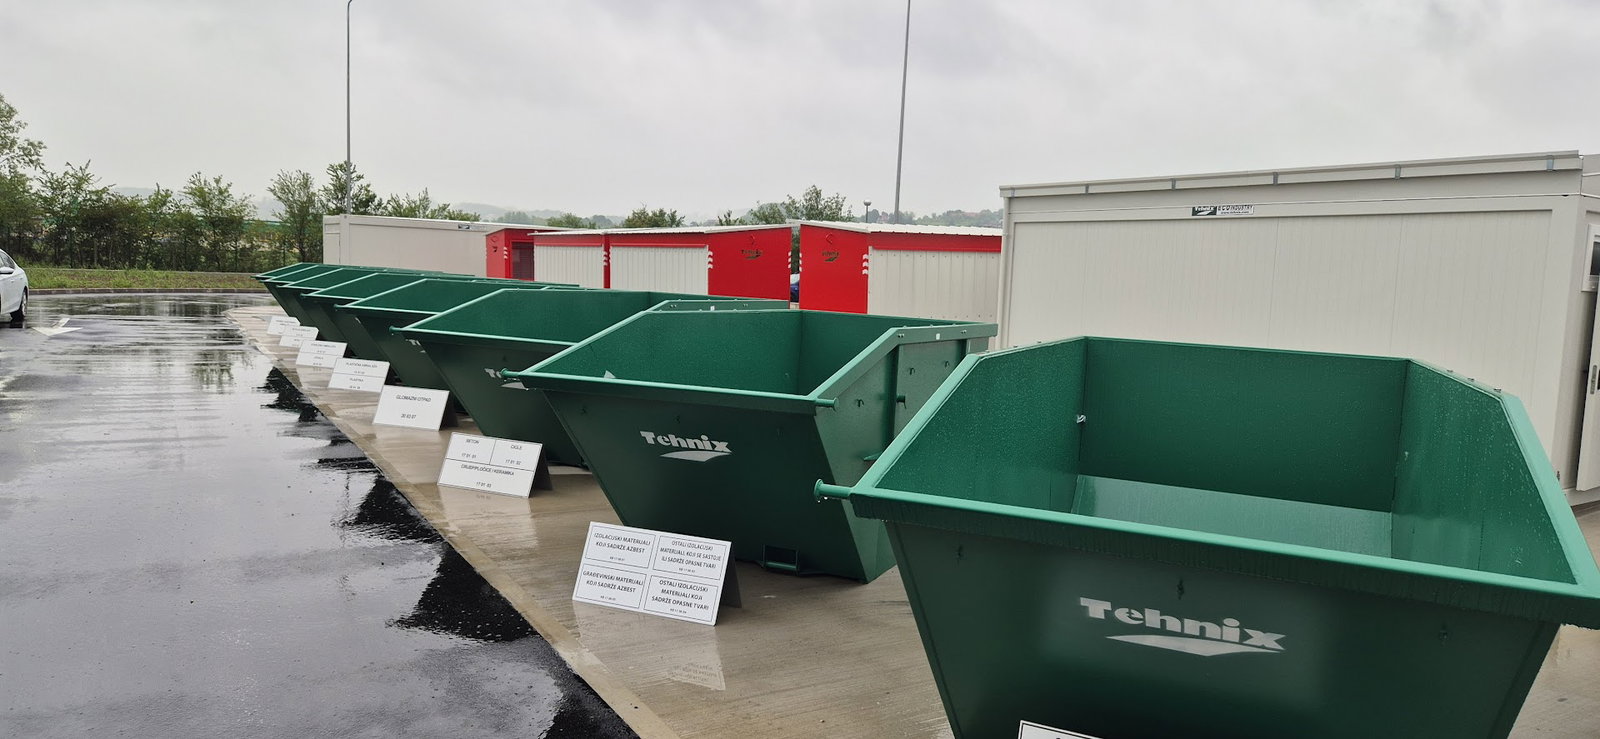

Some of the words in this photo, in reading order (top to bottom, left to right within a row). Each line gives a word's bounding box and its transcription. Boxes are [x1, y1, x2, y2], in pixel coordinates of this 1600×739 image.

[640, 430, 732, 453] Tehnix
[594, 533, 622, 541] IZOLACIJSKI
[623, 537, 651, 546] MATERIJALI
[687, 542, 713, 550] IZOLACIJSKI
[583, 570, 615, 580] GRAĐEVINSKI
[615, 576, 644, 586] MATERIJALI
[598, 581, 616, 590] SADRŽE
[678, 583, 709, 592] IZOLACIJSKI
[661, 589, 690, 598] MATERIJALI
[672, 599, 692, 607] OPASNE
[1079, 596, 1286, 650] Tehnix
